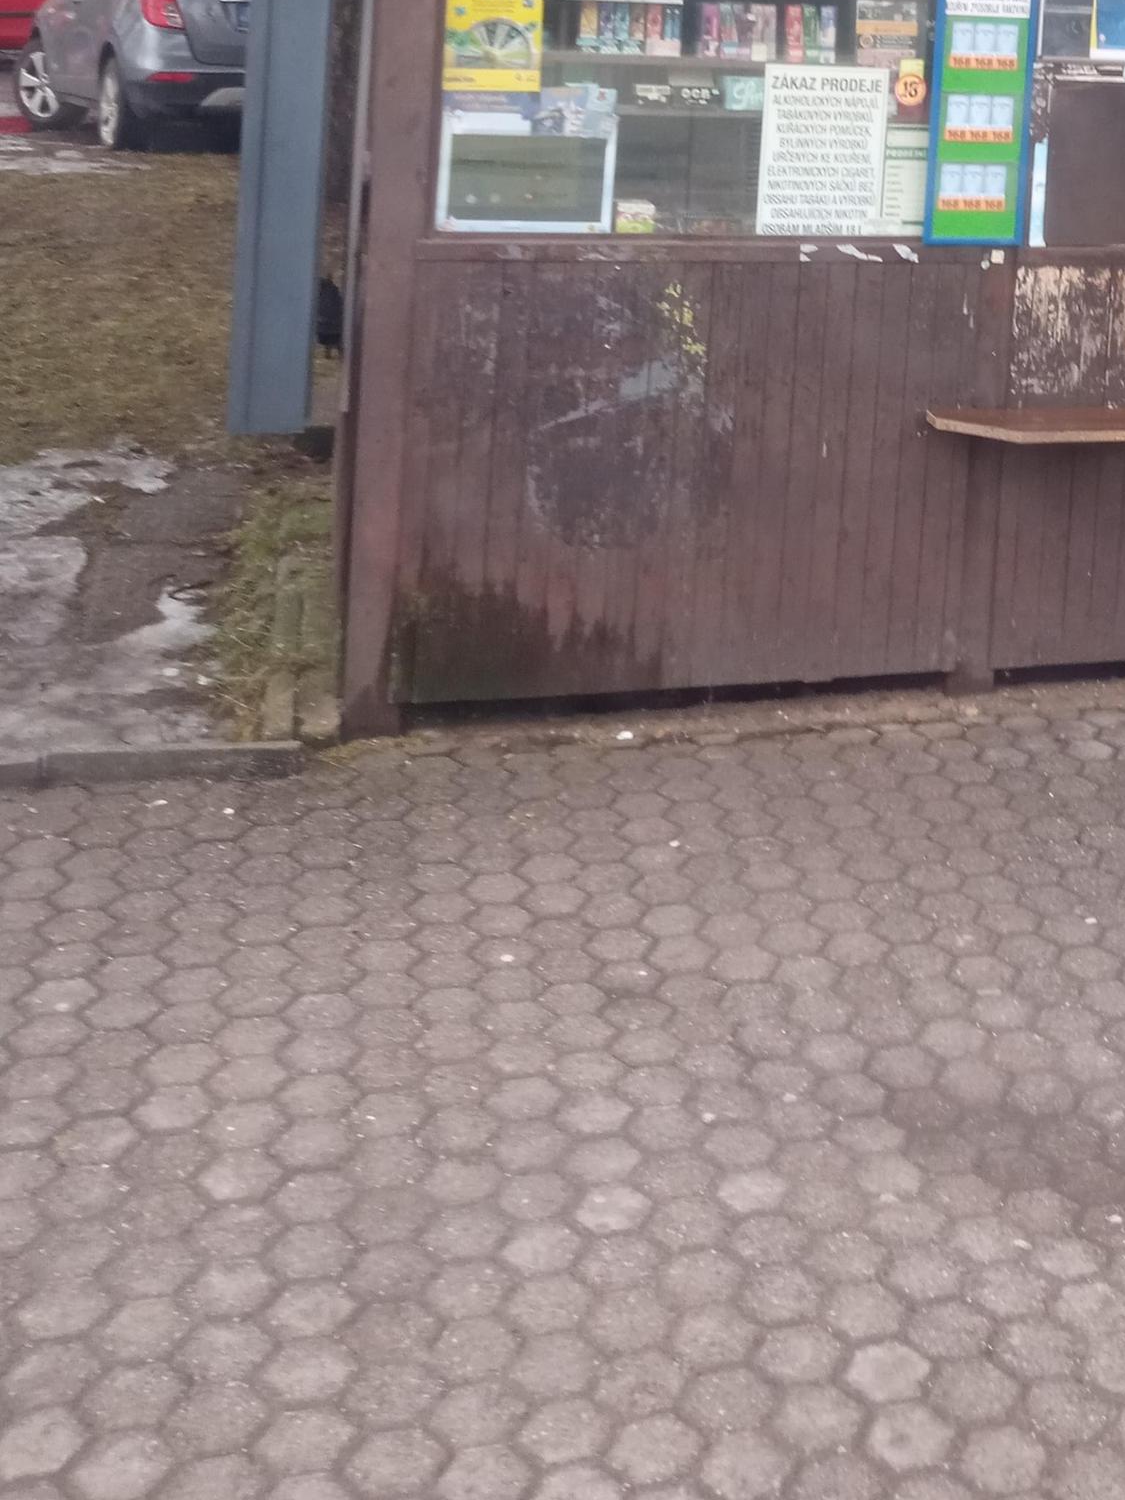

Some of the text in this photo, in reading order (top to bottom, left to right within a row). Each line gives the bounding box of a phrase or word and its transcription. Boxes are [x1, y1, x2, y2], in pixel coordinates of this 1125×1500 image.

[771, 73, 883, 93] ZÁKAZ PRODEJE
[776, 108, 831, 121] TABÁKOVÝCH
[767, 165, 839, 178] ELEKTRONICKÝCH
[767, 179, 828, 191] NIKOTINOVÝCH
